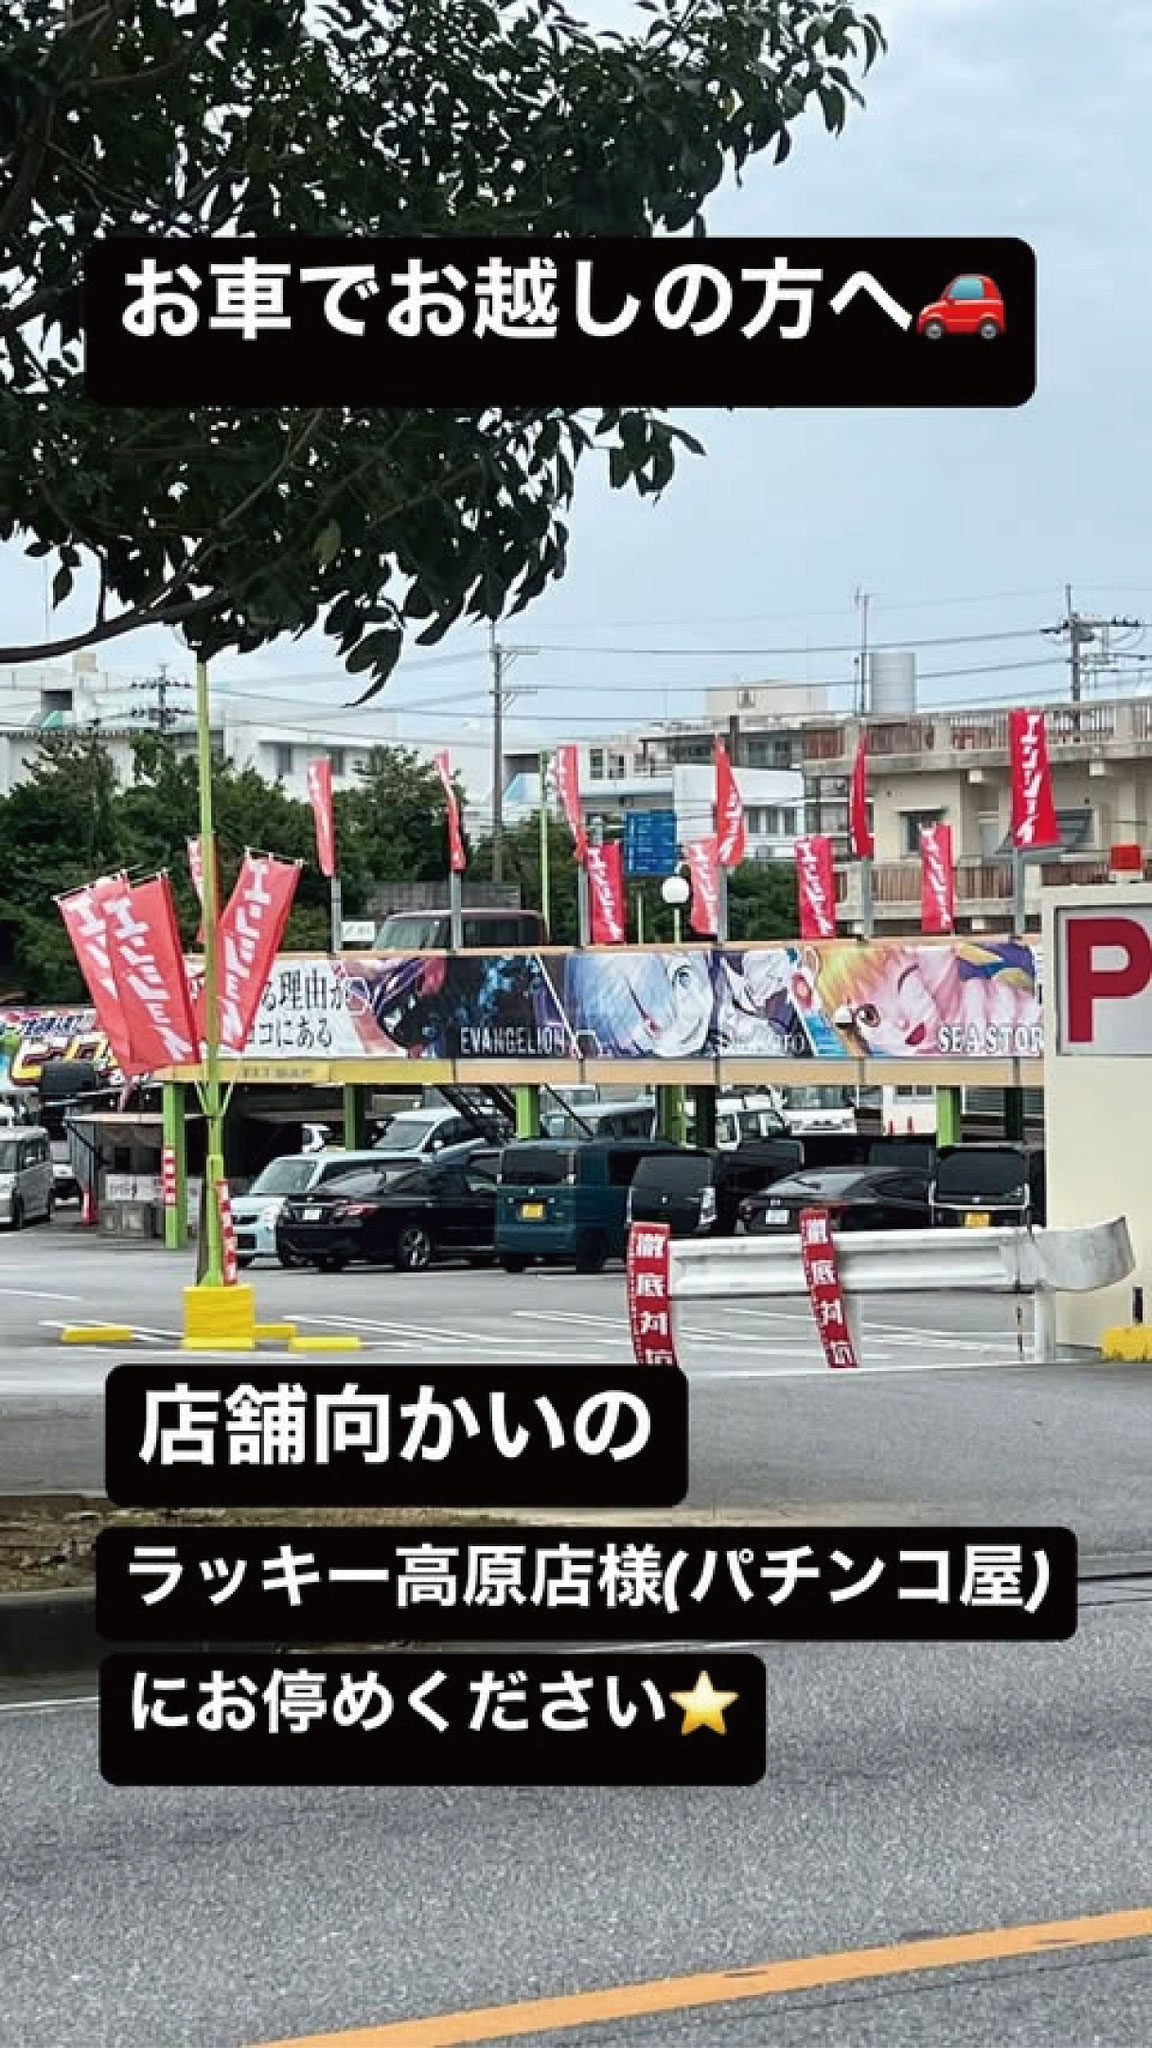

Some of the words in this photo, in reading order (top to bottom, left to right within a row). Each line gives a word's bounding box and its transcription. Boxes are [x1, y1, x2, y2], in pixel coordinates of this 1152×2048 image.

[1018, 714, 1041, 844] エンジョイ
[1066, 917, 1152, 1042] P
[460, 1026, 565, 1055] EVANGELION
[939, 1025, 981, 1053] SEA
